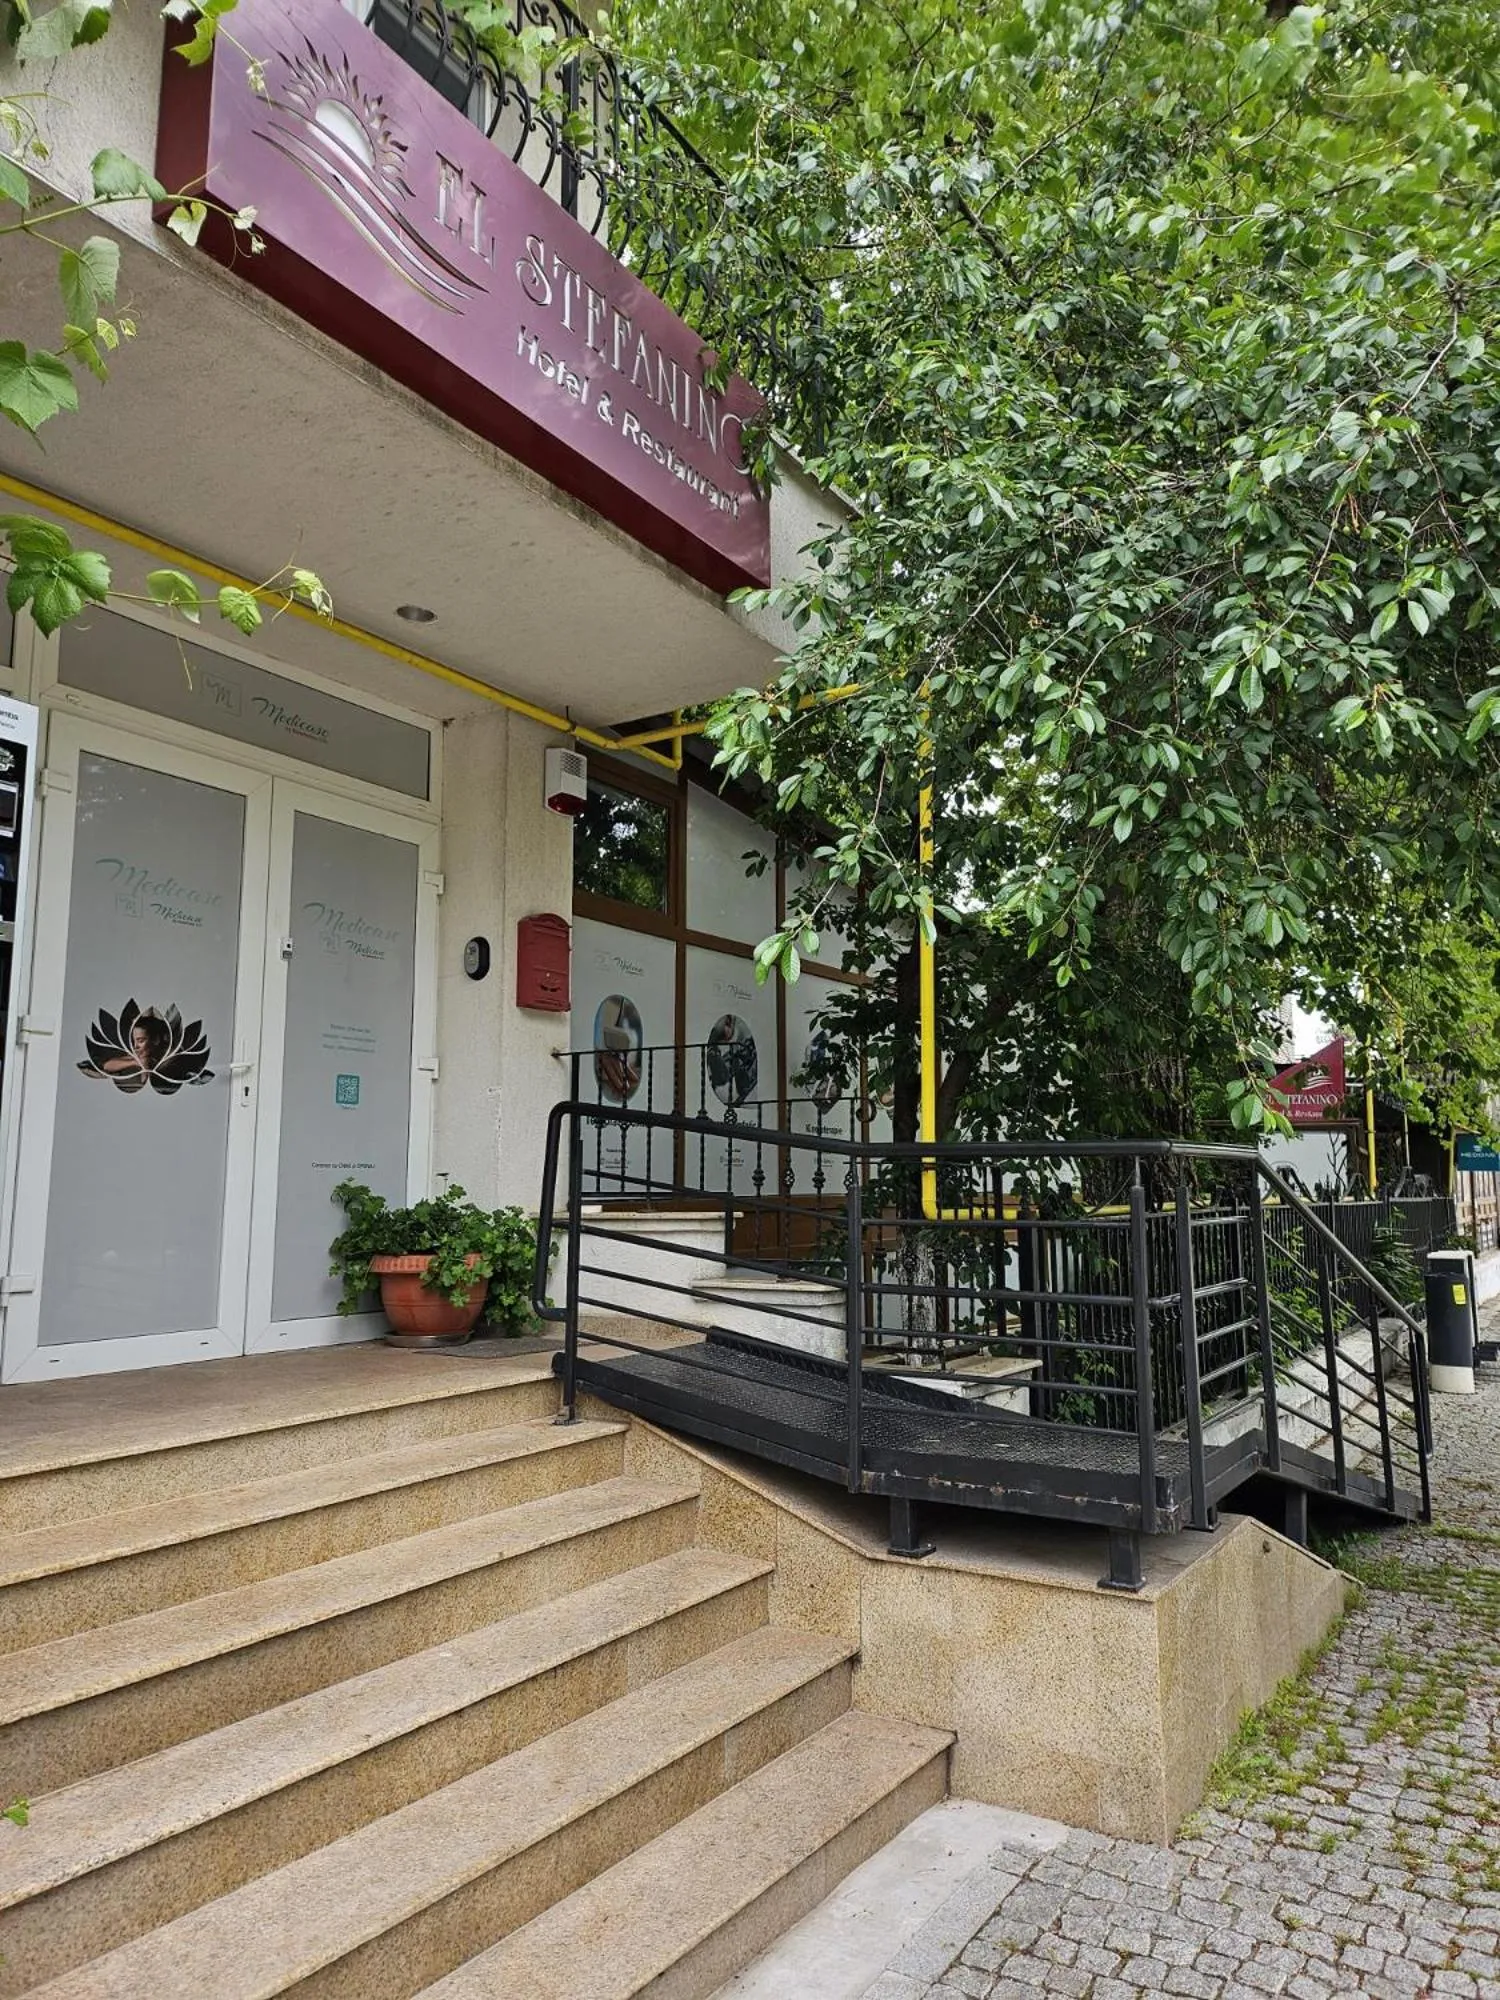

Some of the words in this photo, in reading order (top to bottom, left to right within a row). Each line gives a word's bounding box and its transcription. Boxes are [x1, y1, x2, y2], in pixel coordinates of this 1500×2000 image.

[433, 150, 497, 271] EL
[515, 233, 752, 475] STEFANINO
[516, 325, 591, 405] Hotel
[597, 390, 616, 427] &
[621, 410, 741, 518] Restaurant
